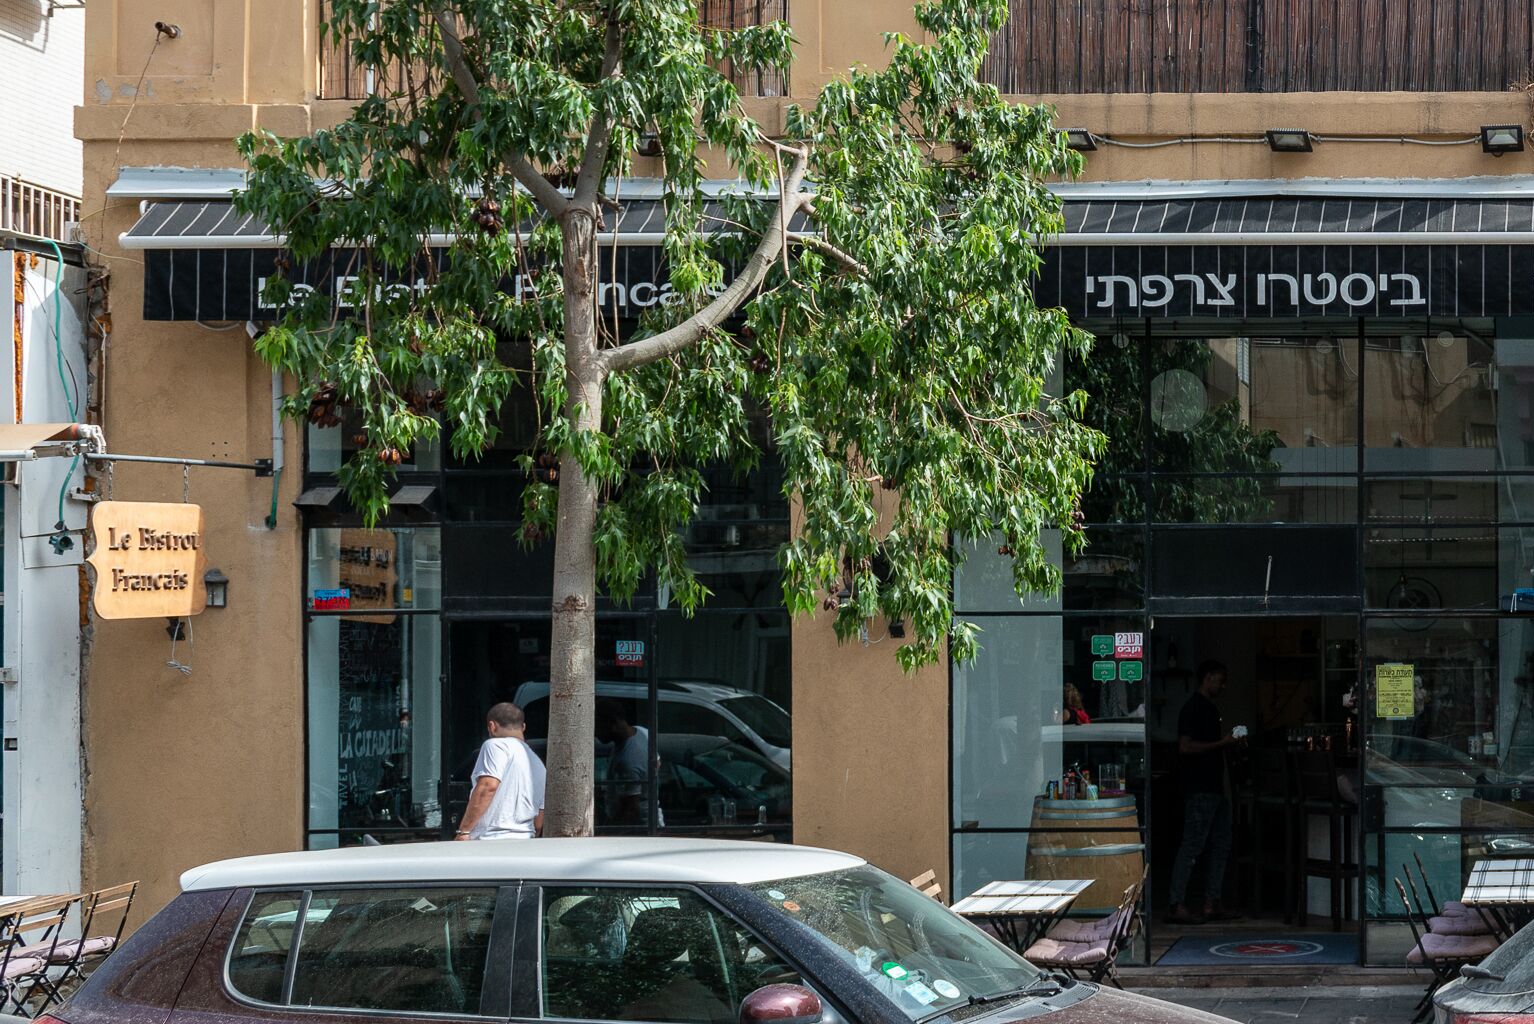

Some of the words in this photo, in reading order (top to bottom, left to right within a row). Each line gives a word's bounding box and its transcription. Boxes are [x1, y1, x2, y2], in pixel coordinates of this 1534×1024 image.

[1086, 273, 1236, 307] צרפתי
[1257, 273, 1426, 307] ביסטרו
[108, 527, 132, 551] Le
[138, 527, 201, 551] Bistrot
[111, 568, 189, 592] Francais
[1117, 633, 1141, 645] רעב?
